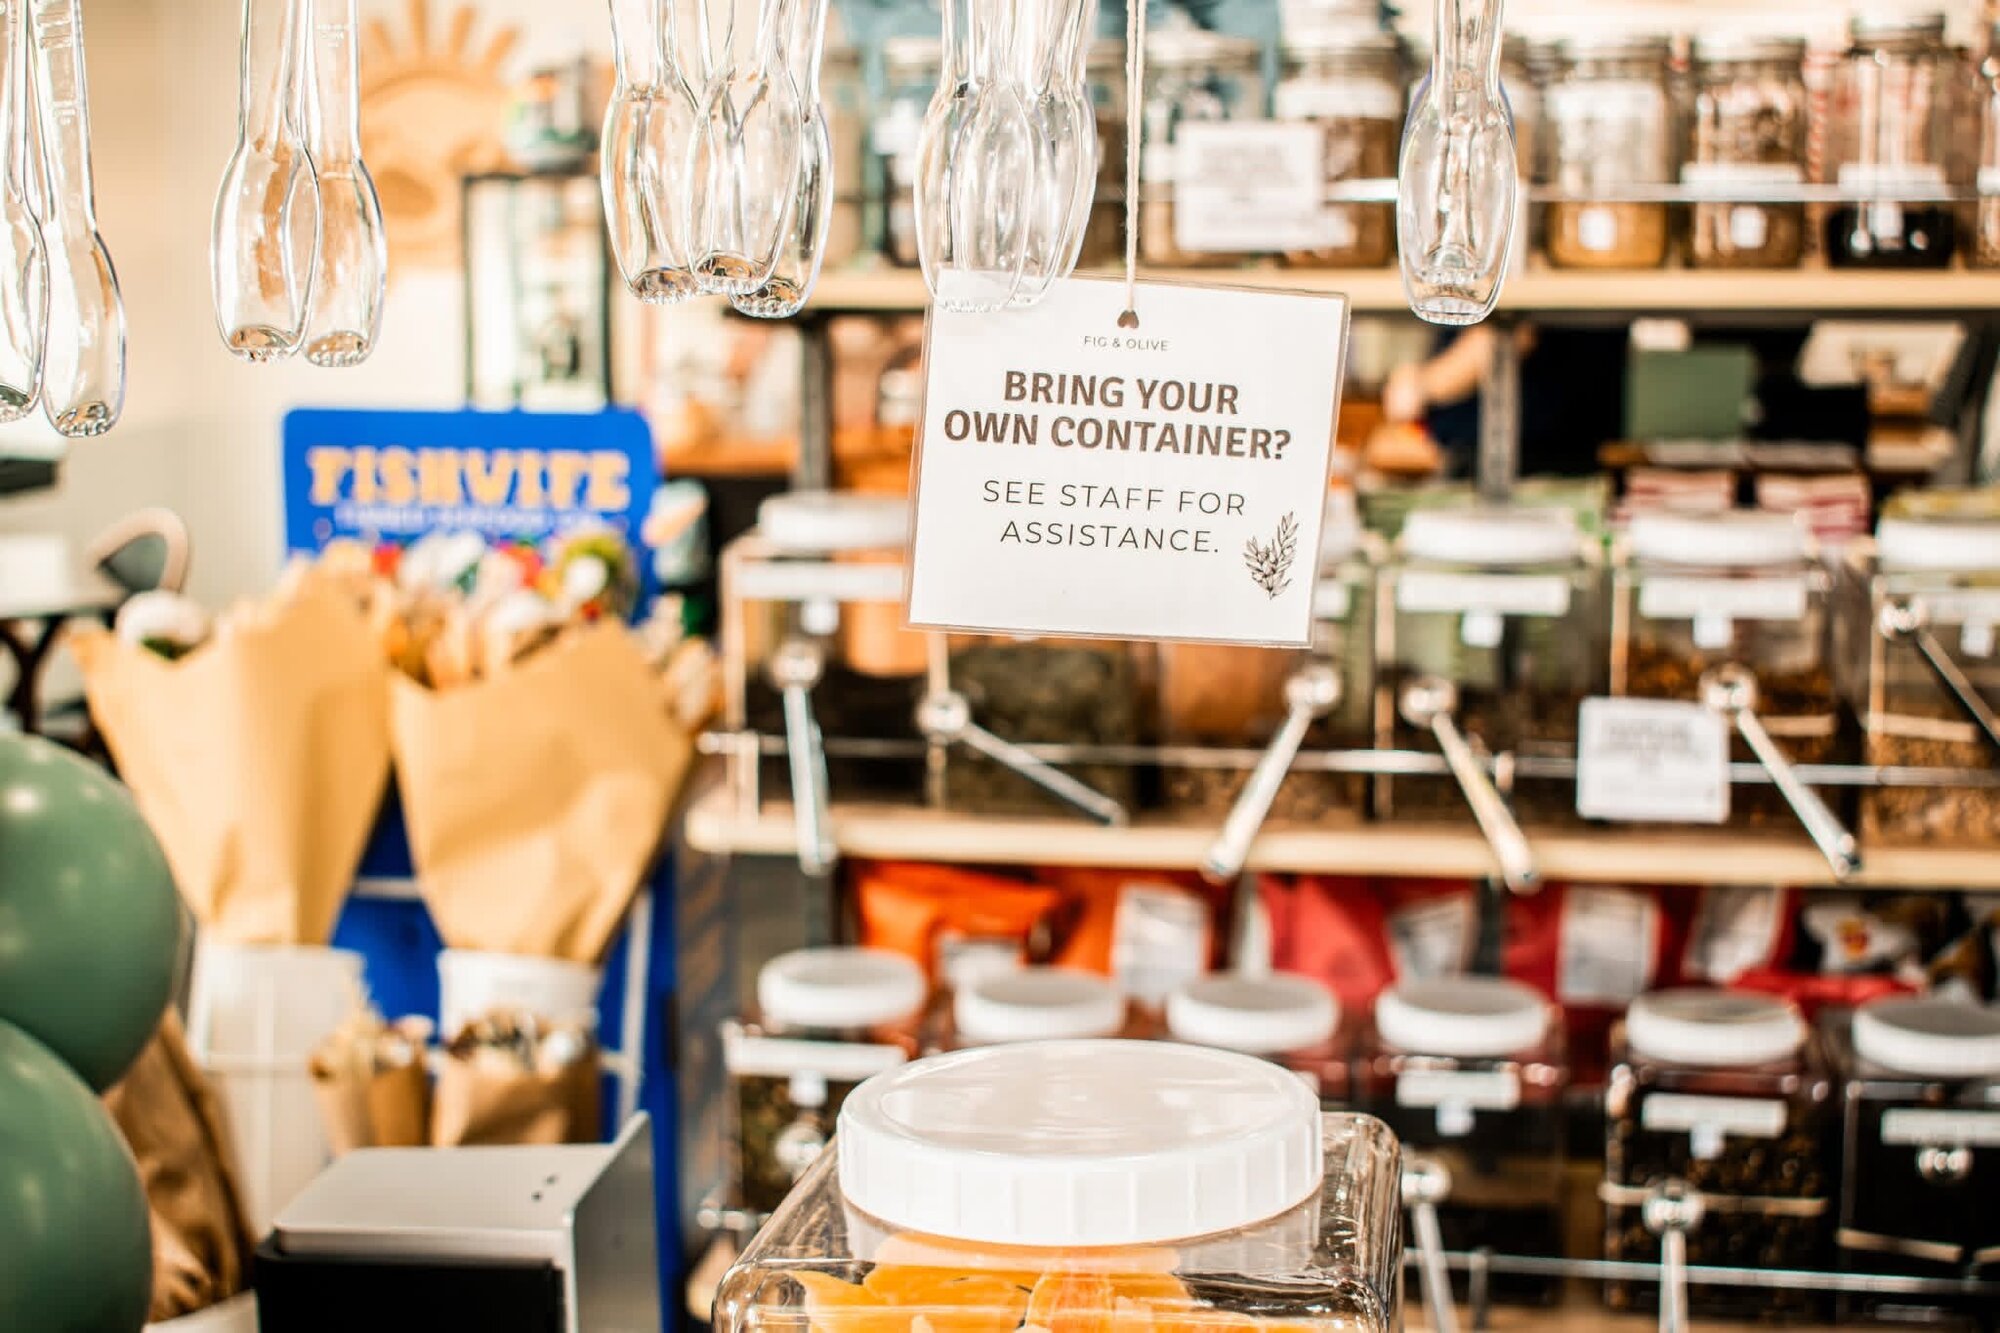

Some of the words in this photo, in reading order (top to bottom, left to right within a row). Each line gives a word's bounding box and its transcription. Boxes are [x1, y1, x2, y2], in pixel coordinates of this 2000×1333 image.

[1084, 335, 1107, 347] FIG
[1112, 337, 1121, 349] &
[1126, 338, 1168, 351] OLIVE
[1003, 369, 1125, 409] BRING
[1135, 377, 1239, 415] YOUR
[943, 408, 1039, 446] OWN
[1050, 415, 1292, 460] CONTAINER?
[983, 479, 1046, 506] SEE
[1059, 483, 1165, 512] STAFF
[1178, 490, 1246, 517] FOR
[999, 519, 1219, 554] ASSISTANCE.
